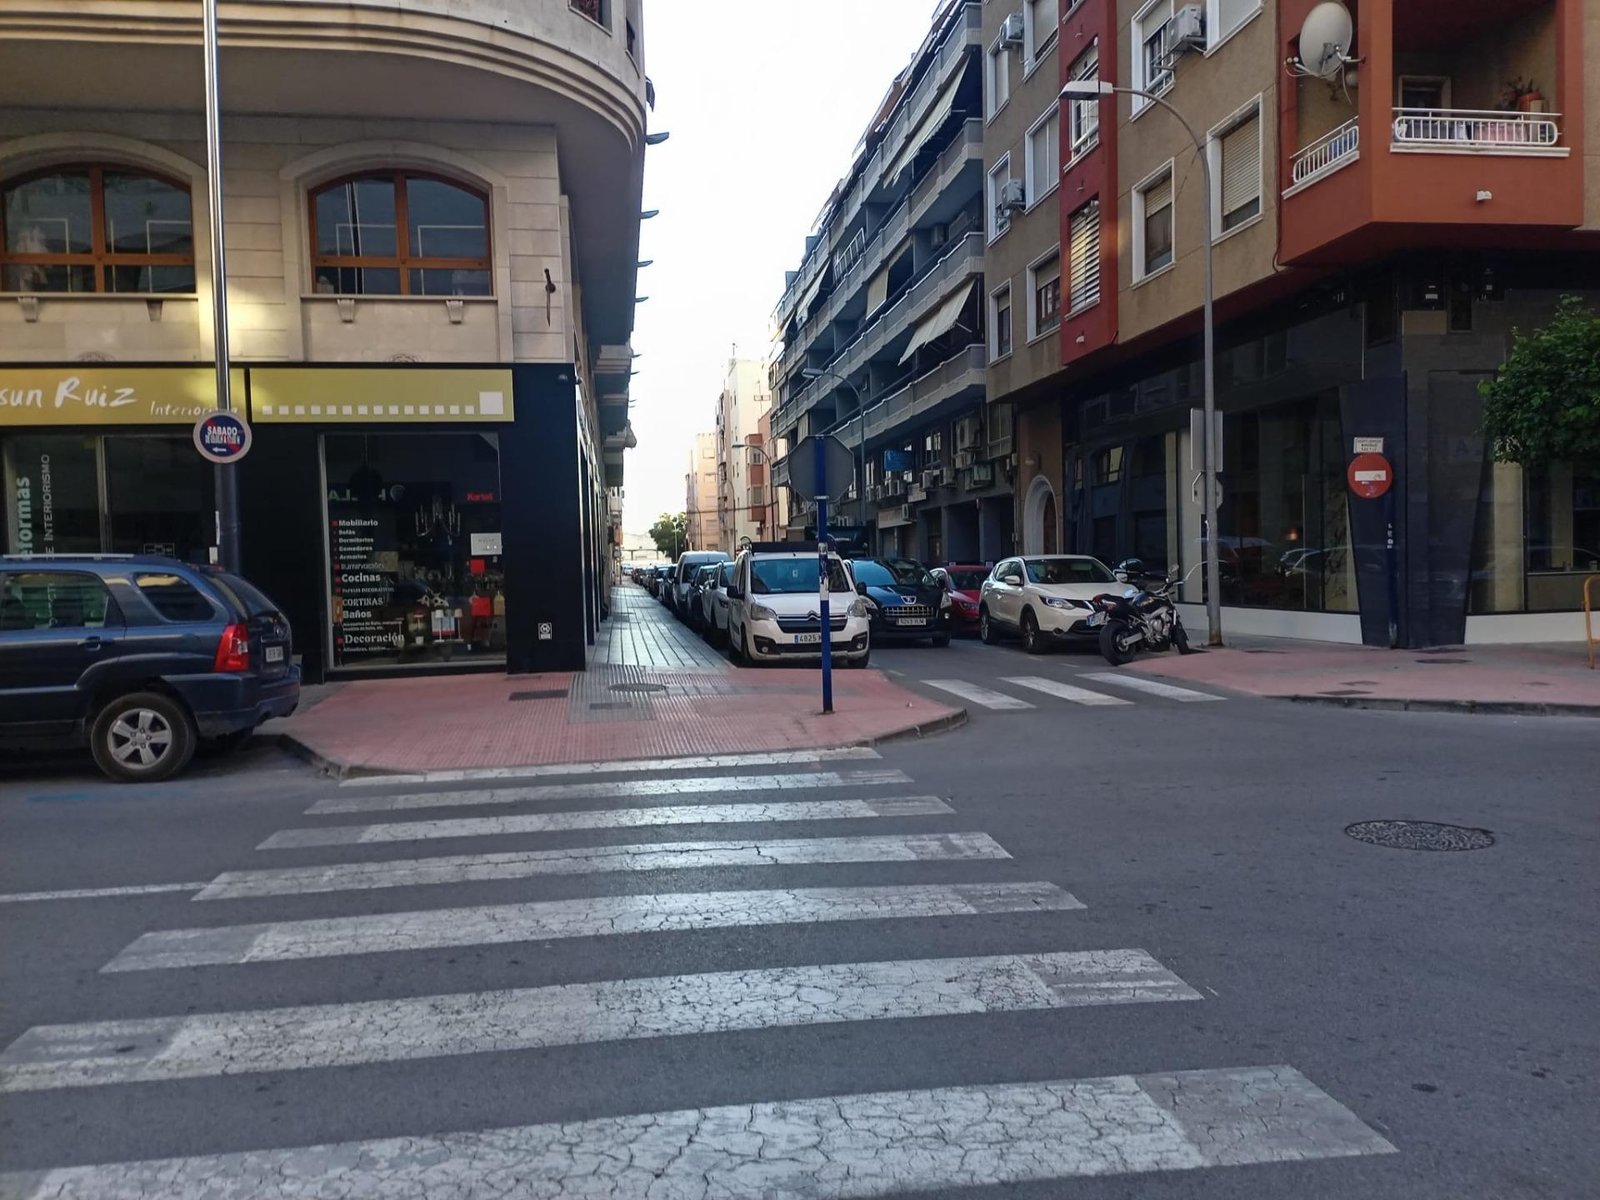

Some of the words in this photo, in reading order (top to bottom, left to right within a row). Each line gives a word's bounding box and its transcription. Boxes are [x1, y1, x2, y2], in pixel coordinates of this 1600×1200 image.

[54, 376, 137, 408] Ruiz
[41, 454, 54, 541] INTERIORISMO
[338, 519, 379, 527] Mobiliario
[341, 572, 381, 583] Cocinas
[342, 598, 384, 607] CORTINAS
[342, 609, 372, 619] Baños
[344, 631, 405, 644] Decoración
